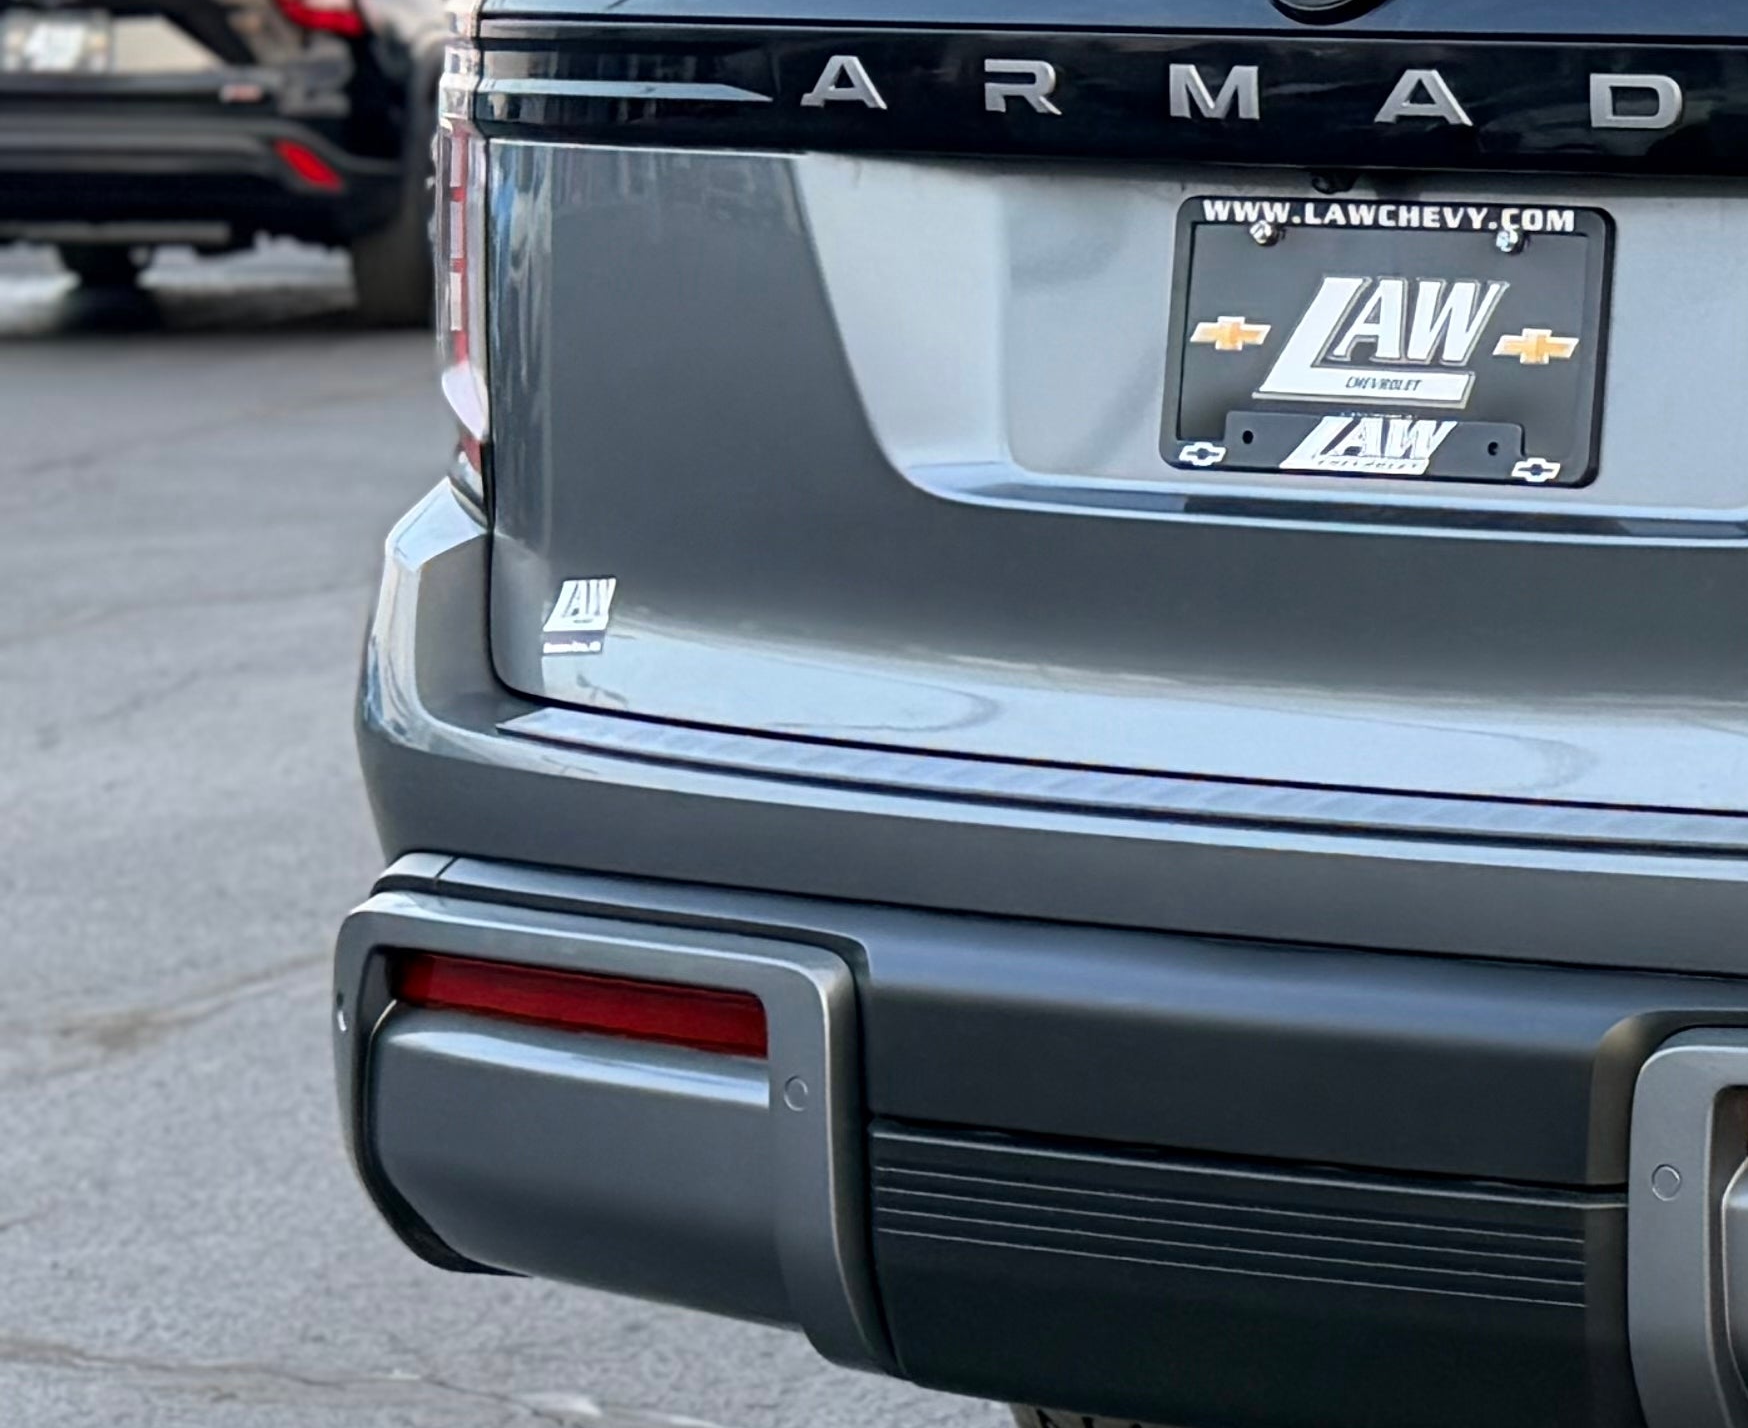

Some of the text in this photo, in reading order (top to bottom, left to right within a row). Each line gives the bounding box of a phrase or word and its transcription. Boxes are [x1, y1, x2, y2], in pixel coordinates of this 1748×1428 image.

[1203, 199, 1575, 233] WWW.LAWCHEVY.COM
[1252, 276, 1510, 410] LAW
[1280, 416, 1458, 475] LAW
